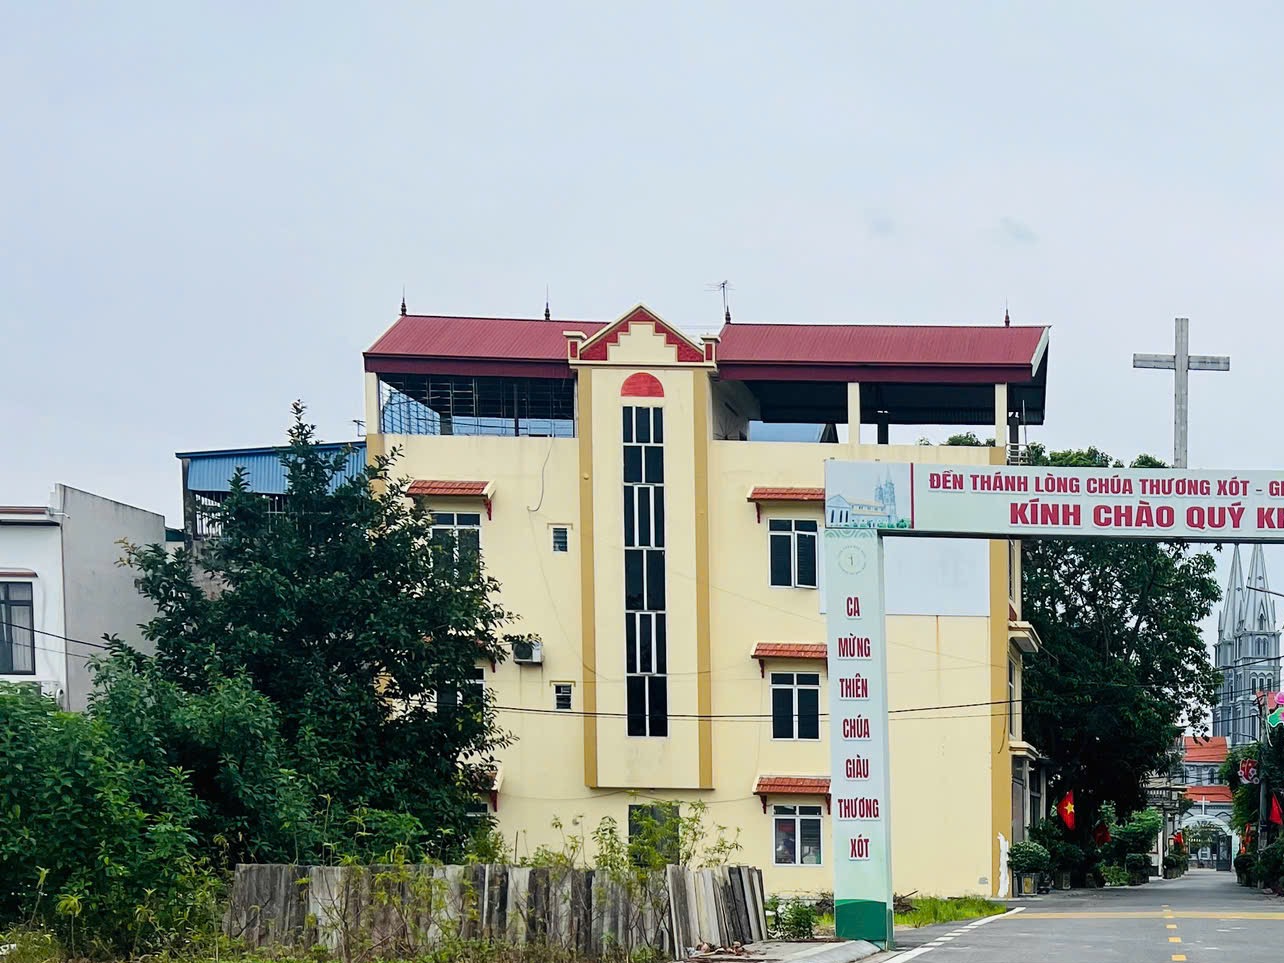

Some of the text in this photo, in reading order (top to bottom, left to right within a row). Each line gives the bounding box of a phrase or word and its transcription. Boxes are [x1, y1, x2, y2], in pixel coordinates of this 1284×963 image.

[929, 470, 964, 489] ĐỀN
[970, 472, 1028, 492] THÁNH
[1035, 473, 1080, 493] LÒNG
[1087, 475, 1133, 494] CHÚA
[1139, 478, 1211, 495] THƯƠNG
[1217, 476, 1250, 496] XÓT
[1010, 498, 1081, 526] KÍNH
[1093, 500, 1175, 528] CHÀO
[1186, 501, 1246, 529] QUÝ
[846, 597, 861, 617] CA
[838, 632, 871, 658] MỪNG
[839, 673, 868, 698] THIÊN
[842, 714, 870, 738] CHÚA
[845, 754, 870, 779] GIÀU
[837, 797, 879, 818] THƯƠNG
[850, 834, 870, 858] XÓT
